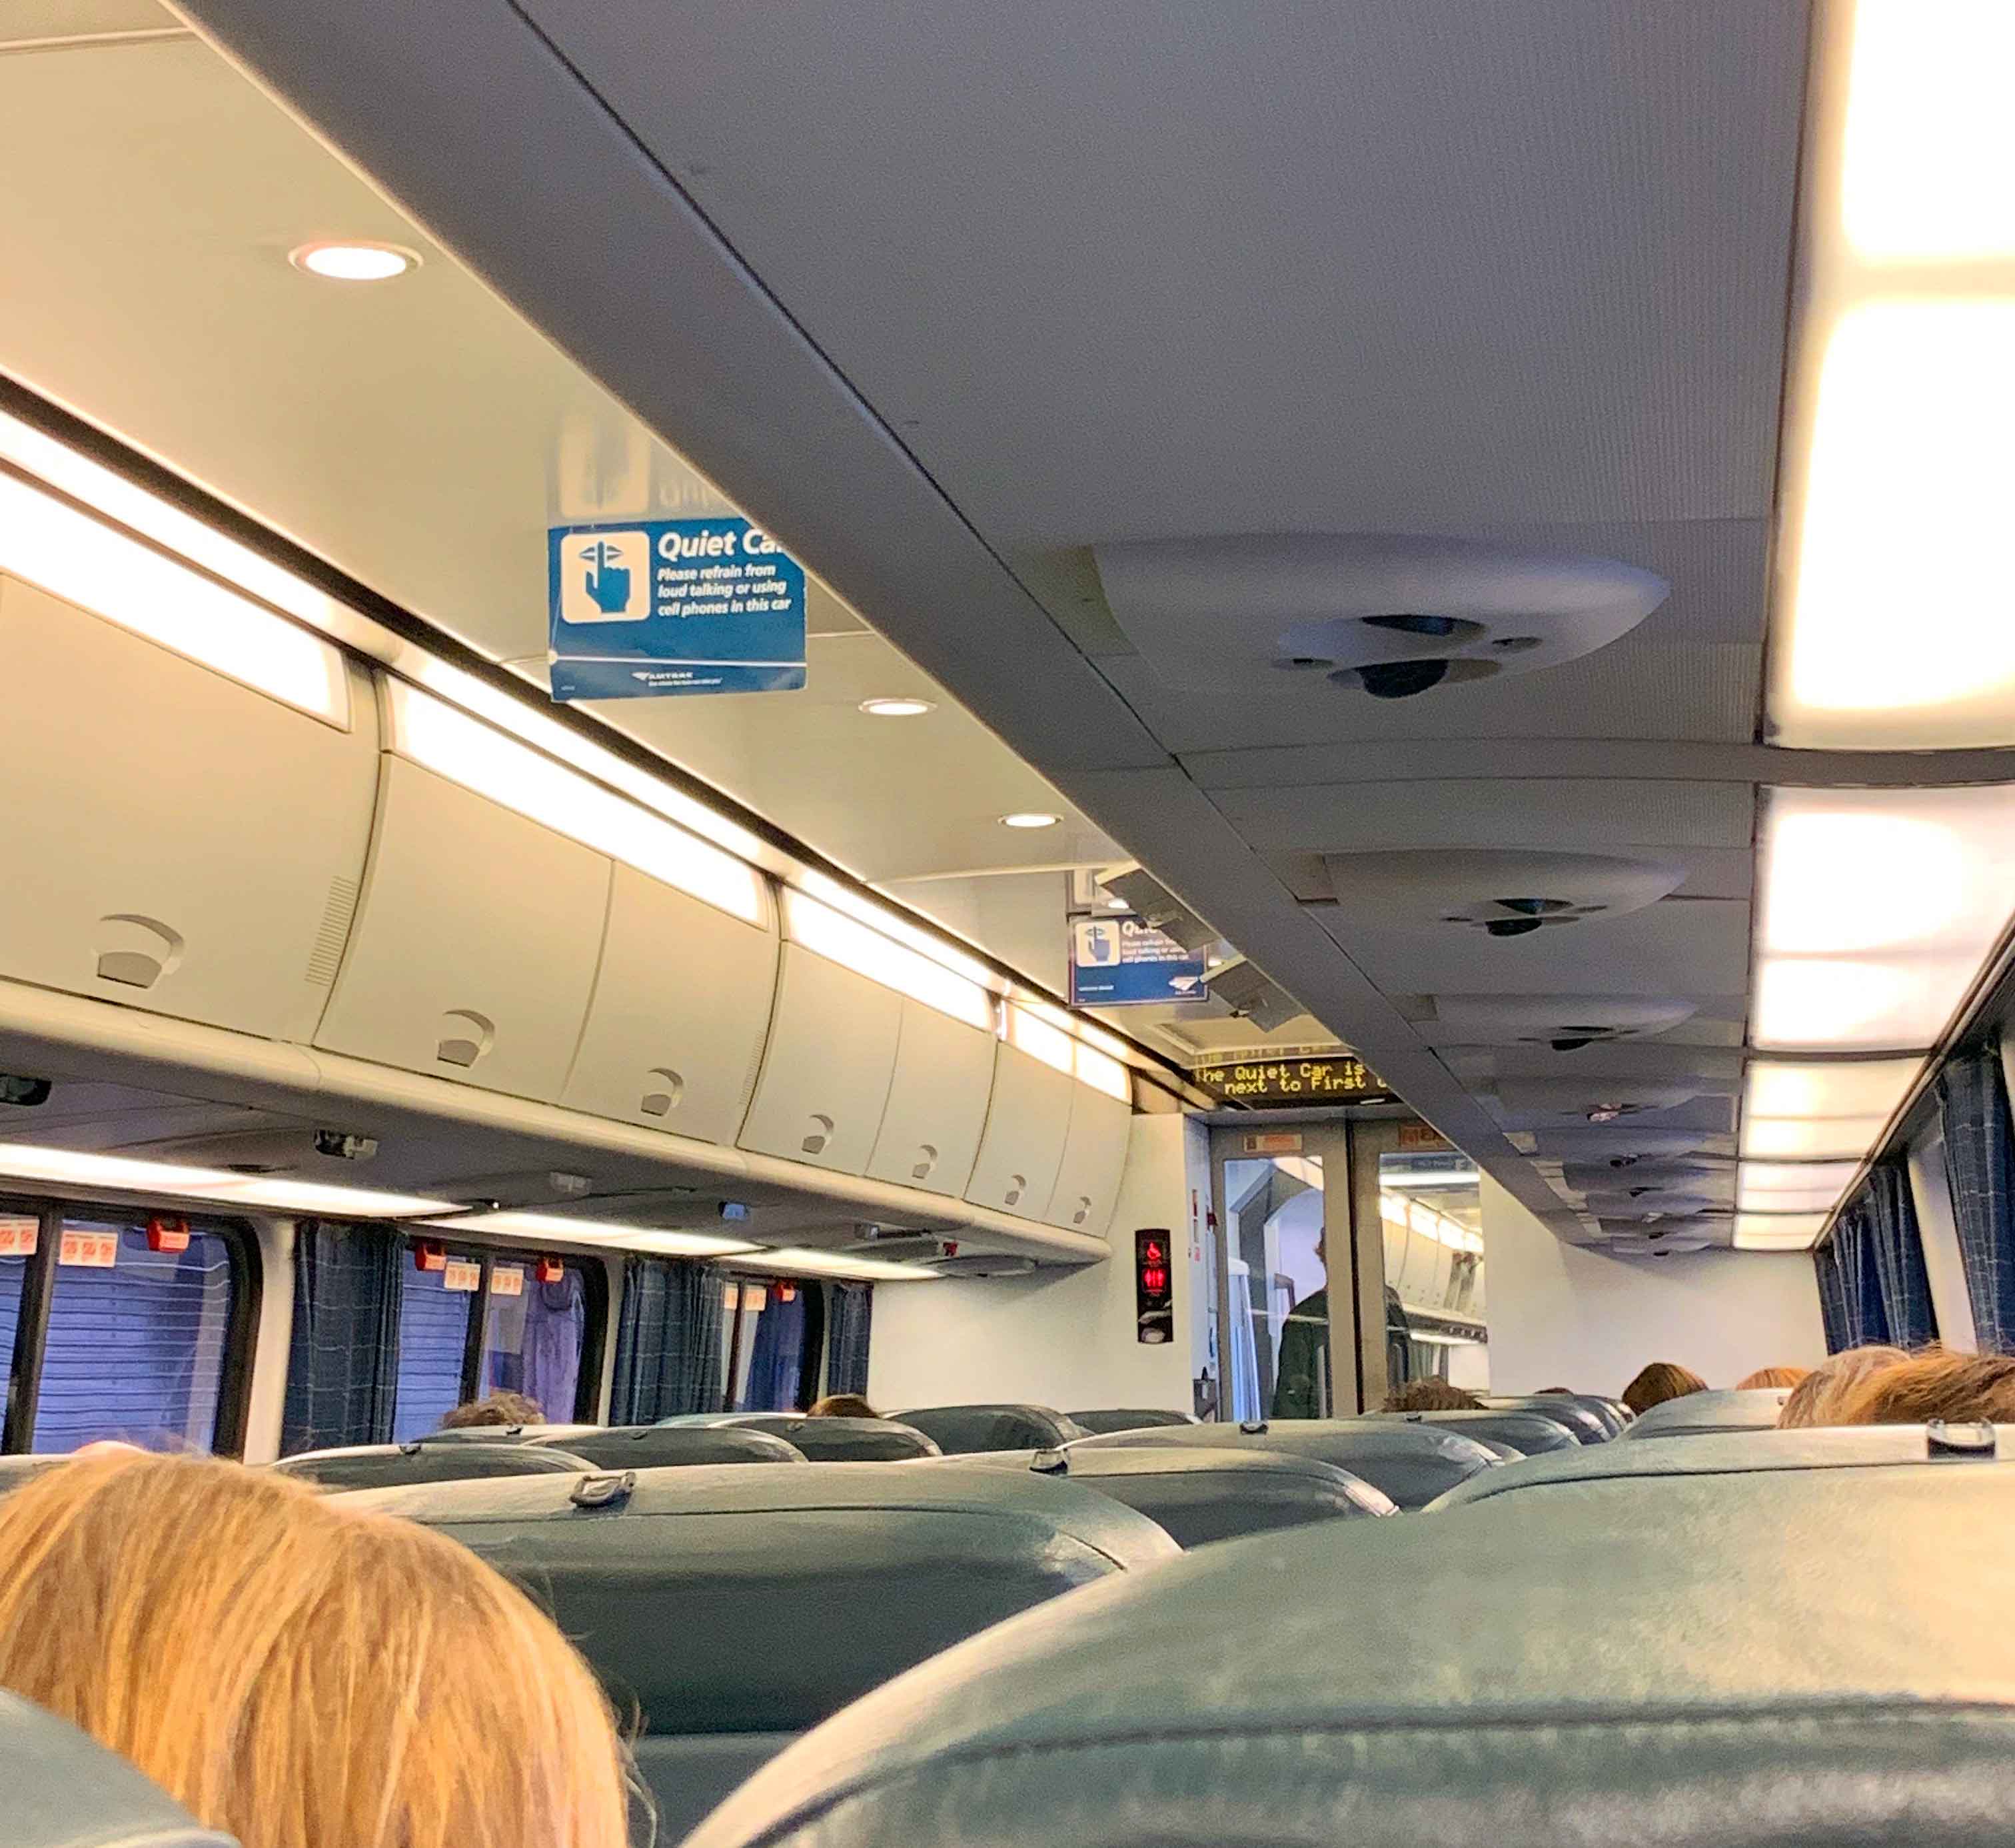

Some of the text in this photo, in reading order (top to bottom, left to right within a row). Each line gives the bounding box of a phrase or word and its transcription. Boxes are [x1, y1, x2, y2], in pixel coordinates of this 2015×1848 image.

[657, 528, 783, 561] Quiet Ca
[657, 563, 776, 581] Please refrain from
[658, 580, 787, 598] loud talking or using
[658, 598, 792, 618] cell phones in this car
[1234, 1064, 1290, 1081] Quiet
[1299, 1062, 1333, 1078] Car
[1345, 1061, 1365, 1076] is
[1224, 1078, 1268, 1095] next
[1280, 1077, 1301, 1092] to
[1311, 1075, 1367, 1090] First
